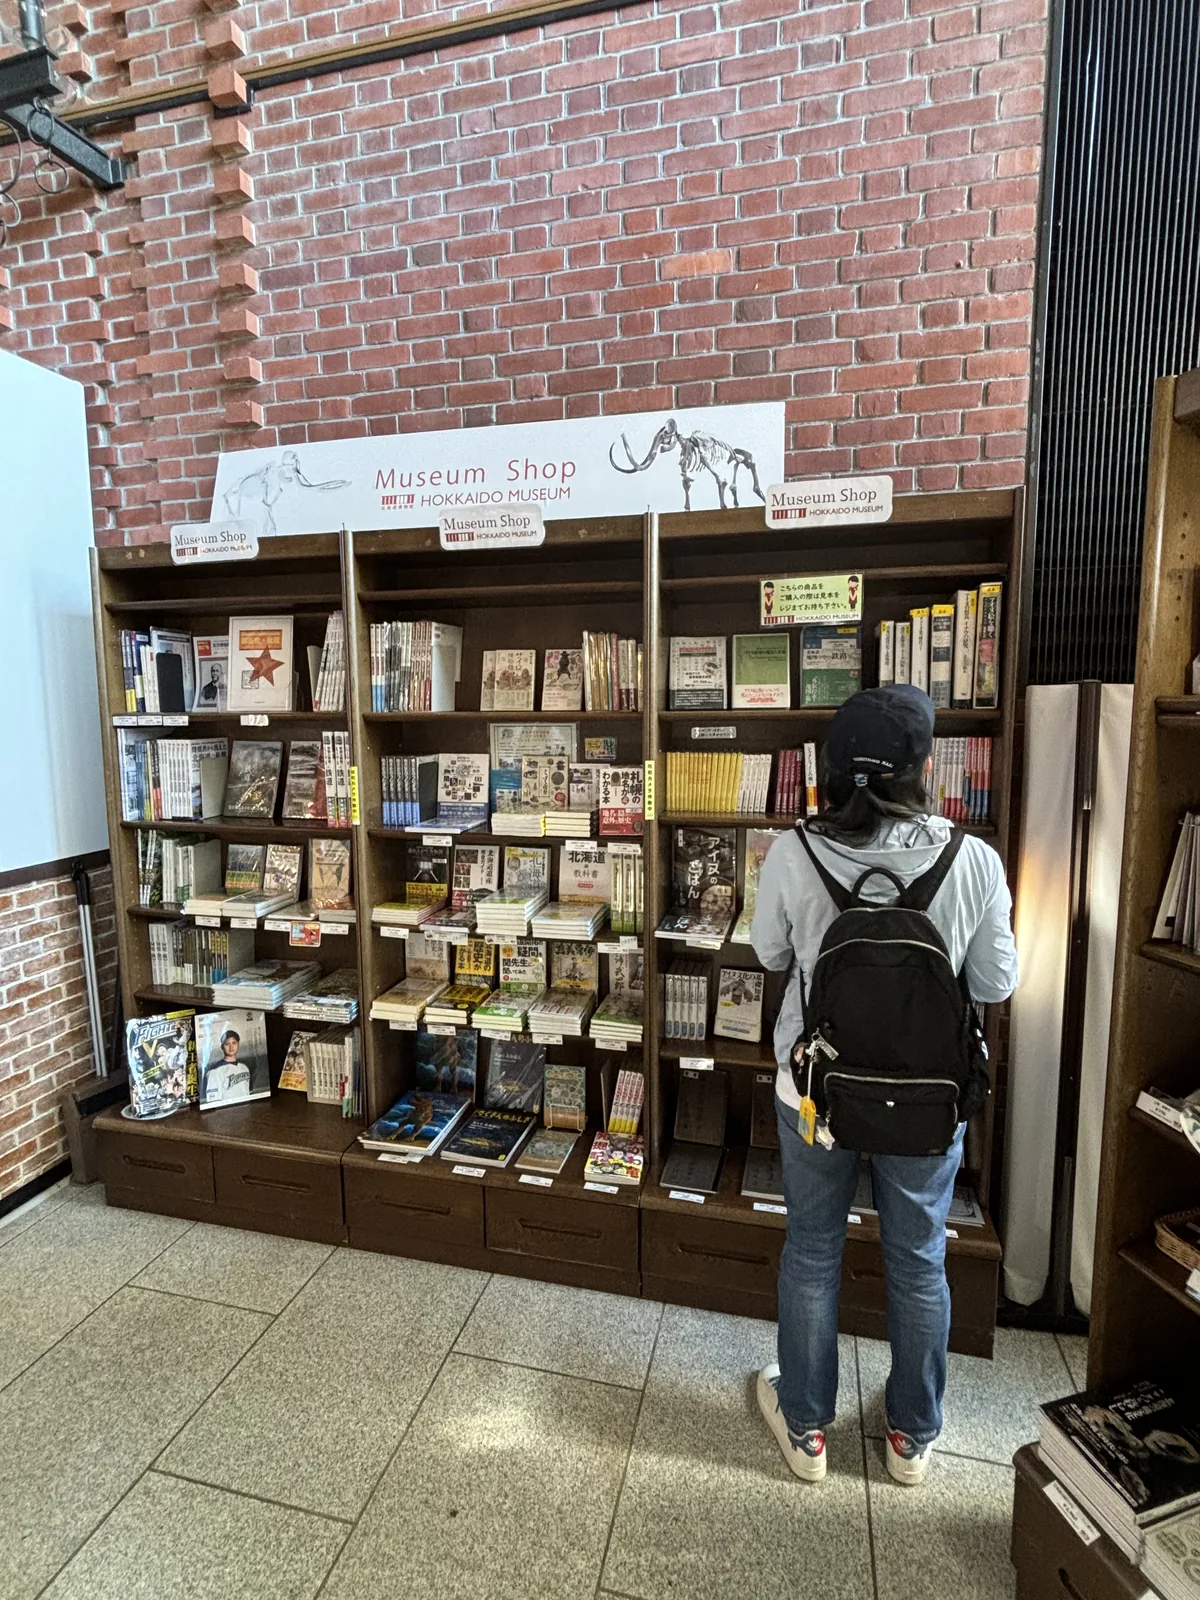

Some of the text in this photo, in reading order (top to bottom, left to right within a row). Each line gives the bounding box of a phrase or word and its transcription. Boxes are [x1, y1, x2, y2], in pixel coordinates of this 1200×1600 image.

[375, 458, 576, 489] Museum Shop
[420, 487, 571, 507] HOKKAIDO MUSEUM
[771, 488, 877, 507] Museum Shop
[809, 505, 883, 517] HOKKAIDO MUSEUM
[443, 514, 531, 531] Museum Shop
[174, 530, 247, 546] Museum Shop
[511, 530, 537, 538] MUSEUM
[780, 583, 824, 592] こちらの商品を
[779, 592, 840, 602] ご購入の際は見本を
[779, 602, 847, 612] レジまでお持ち下さい。
[796, 614, 831, 622] HOKKAIDO
[602, 772, 611, 804] わかる本
[630, 771, 643, 804] 札幌の
[568, 851, 606, 864] 北海道
[707, 836, 720, 885] アイヌの
[574, 870, 599, 879] 教科書
